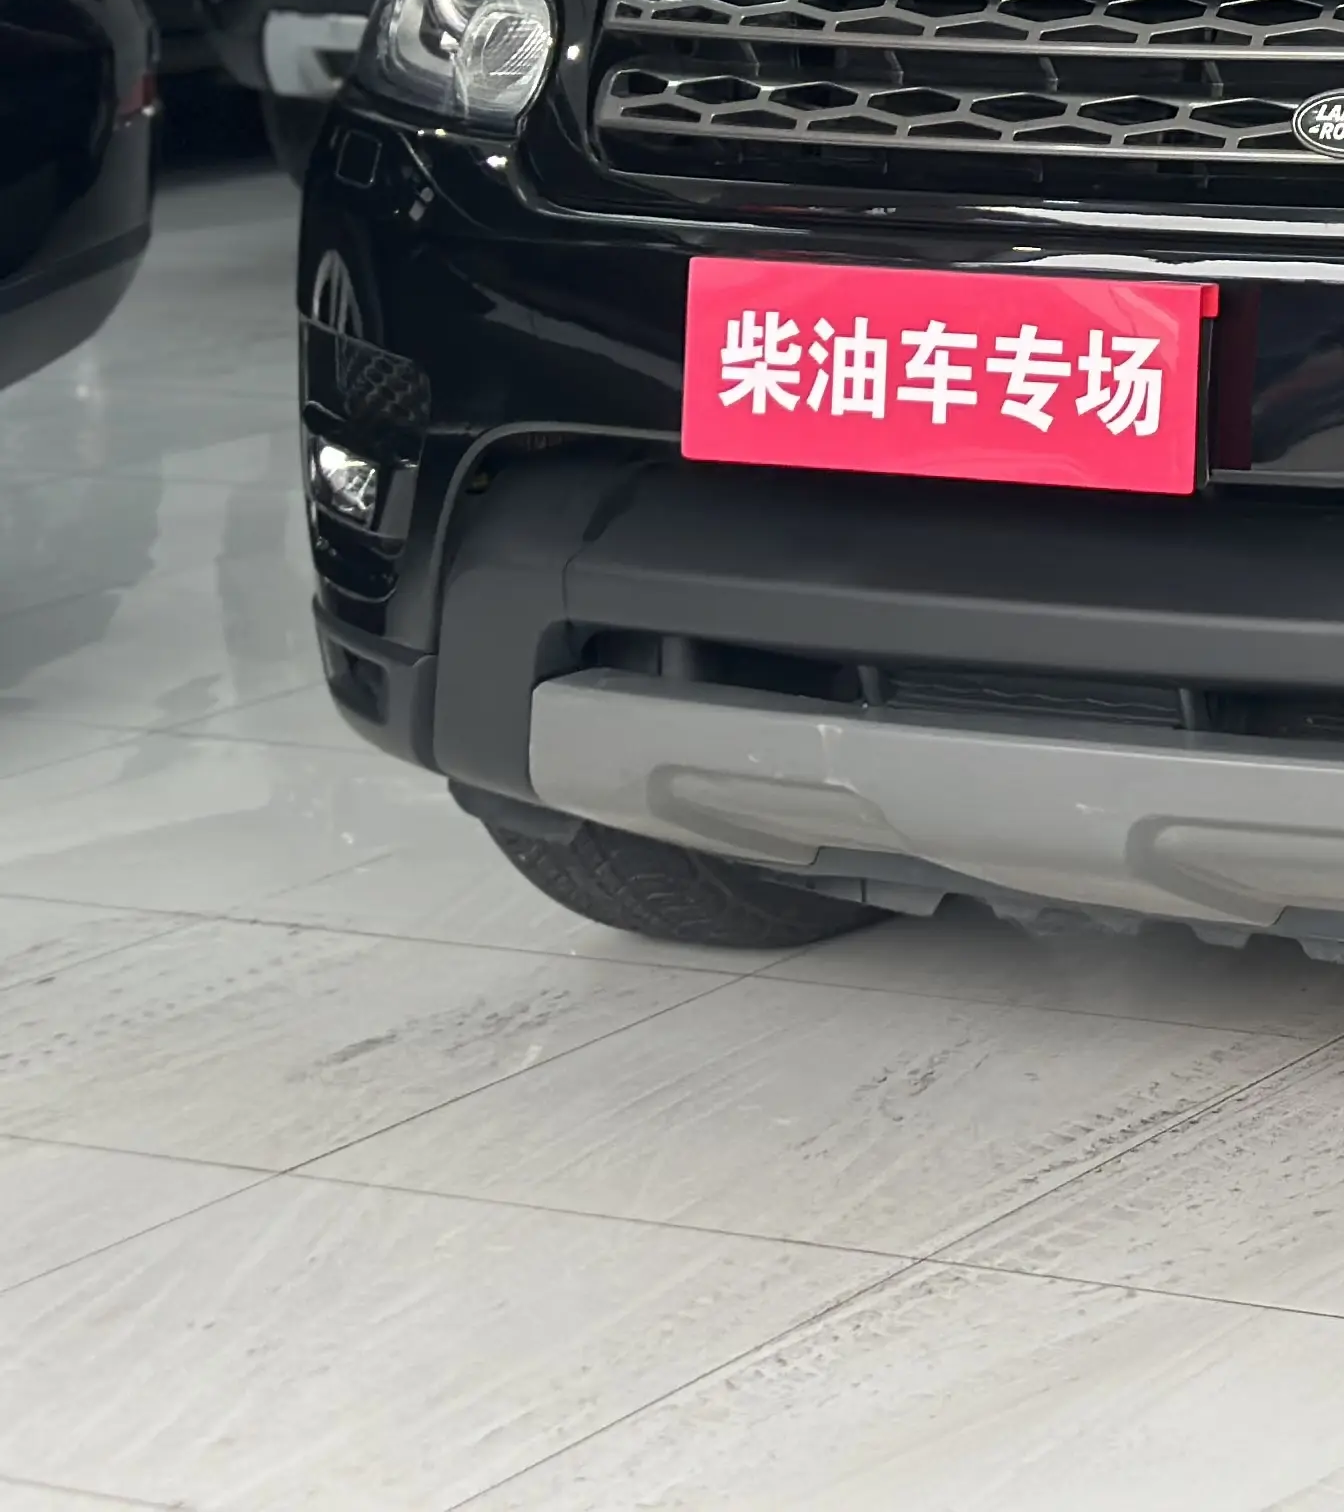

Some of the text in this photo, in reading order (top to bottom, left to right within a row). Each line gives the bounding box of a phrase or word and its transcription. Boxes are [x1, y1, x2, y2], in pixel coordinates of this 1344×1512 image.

[717, 308, 1165, 439] 柴油车专场
